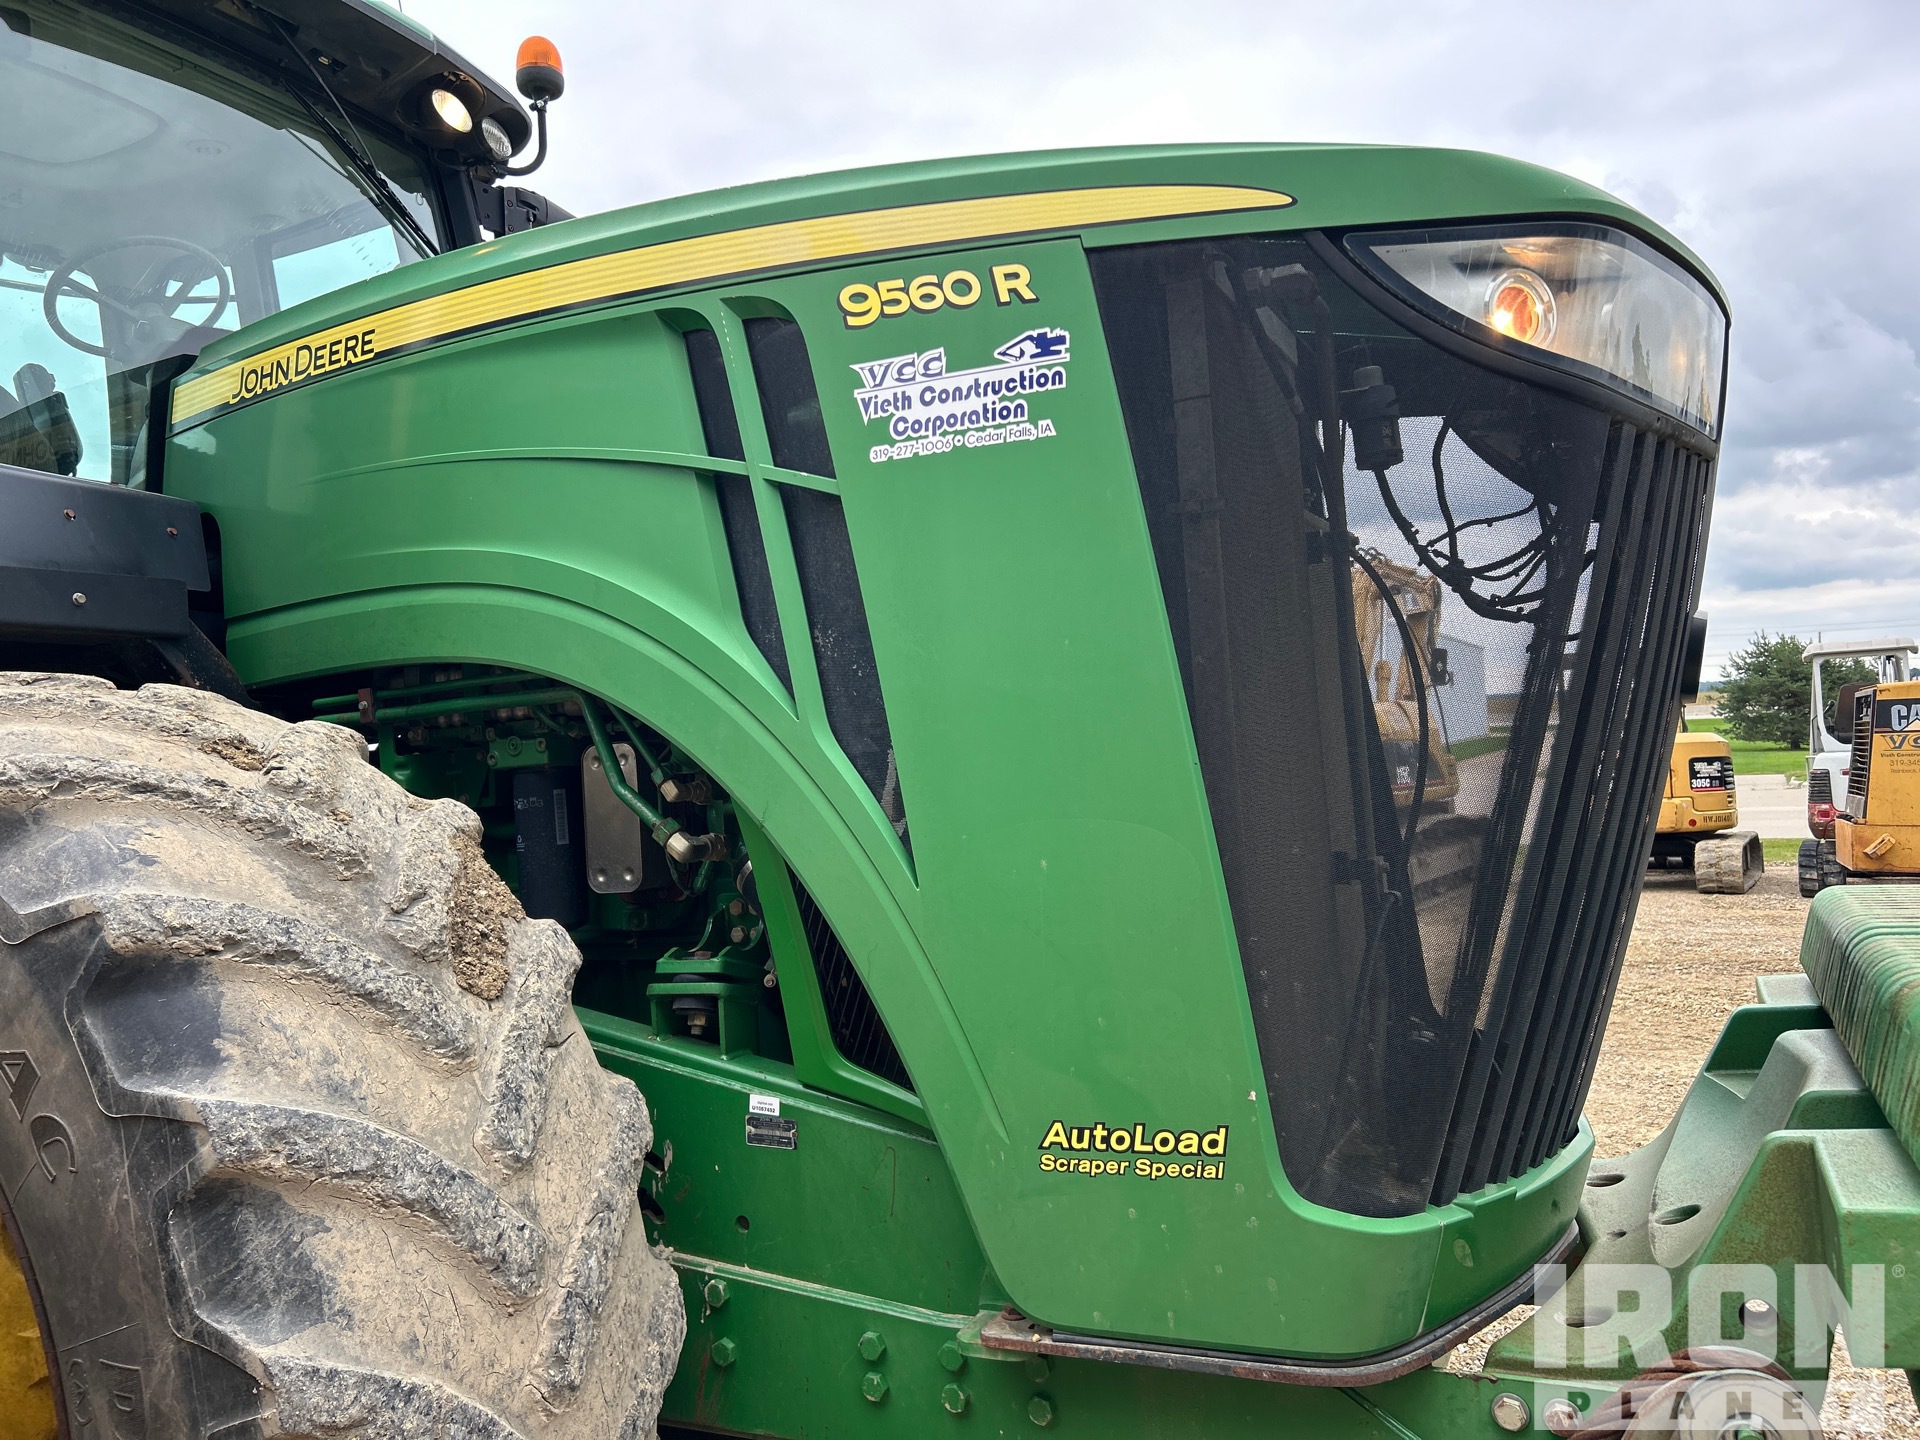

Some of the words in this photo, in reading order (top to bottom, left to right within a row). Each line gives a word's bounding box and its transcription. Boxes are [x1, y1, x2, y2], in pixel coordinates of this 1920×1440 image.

[837, 269, 982, 330] 9560
[989, 263, 1040, 307] R
[232, 355, 291, 401] JOHN
[294, 328, 376, 377] DEERE
[859, 351, 944, 389] VCC
[860, 391, 912, 416] Vieth
[919, 368, 1064, 406] Construction
[892, 400, 1026, 437] Corporation
[872, 438, 952, 460] 319-277-1006
[967, 432, 1003, 445] Cedar
[1008, 426, 1036, 439] Falls,
[1041, 423, 1053, 435] IA
[1691, 778, 1710, 788] 305C
[1038, 1120, 1229, 1157] AutoLoad
[1039, 1153, 1129, 1178] Scraper
[1134, 1158, 1225, 1180] Special
